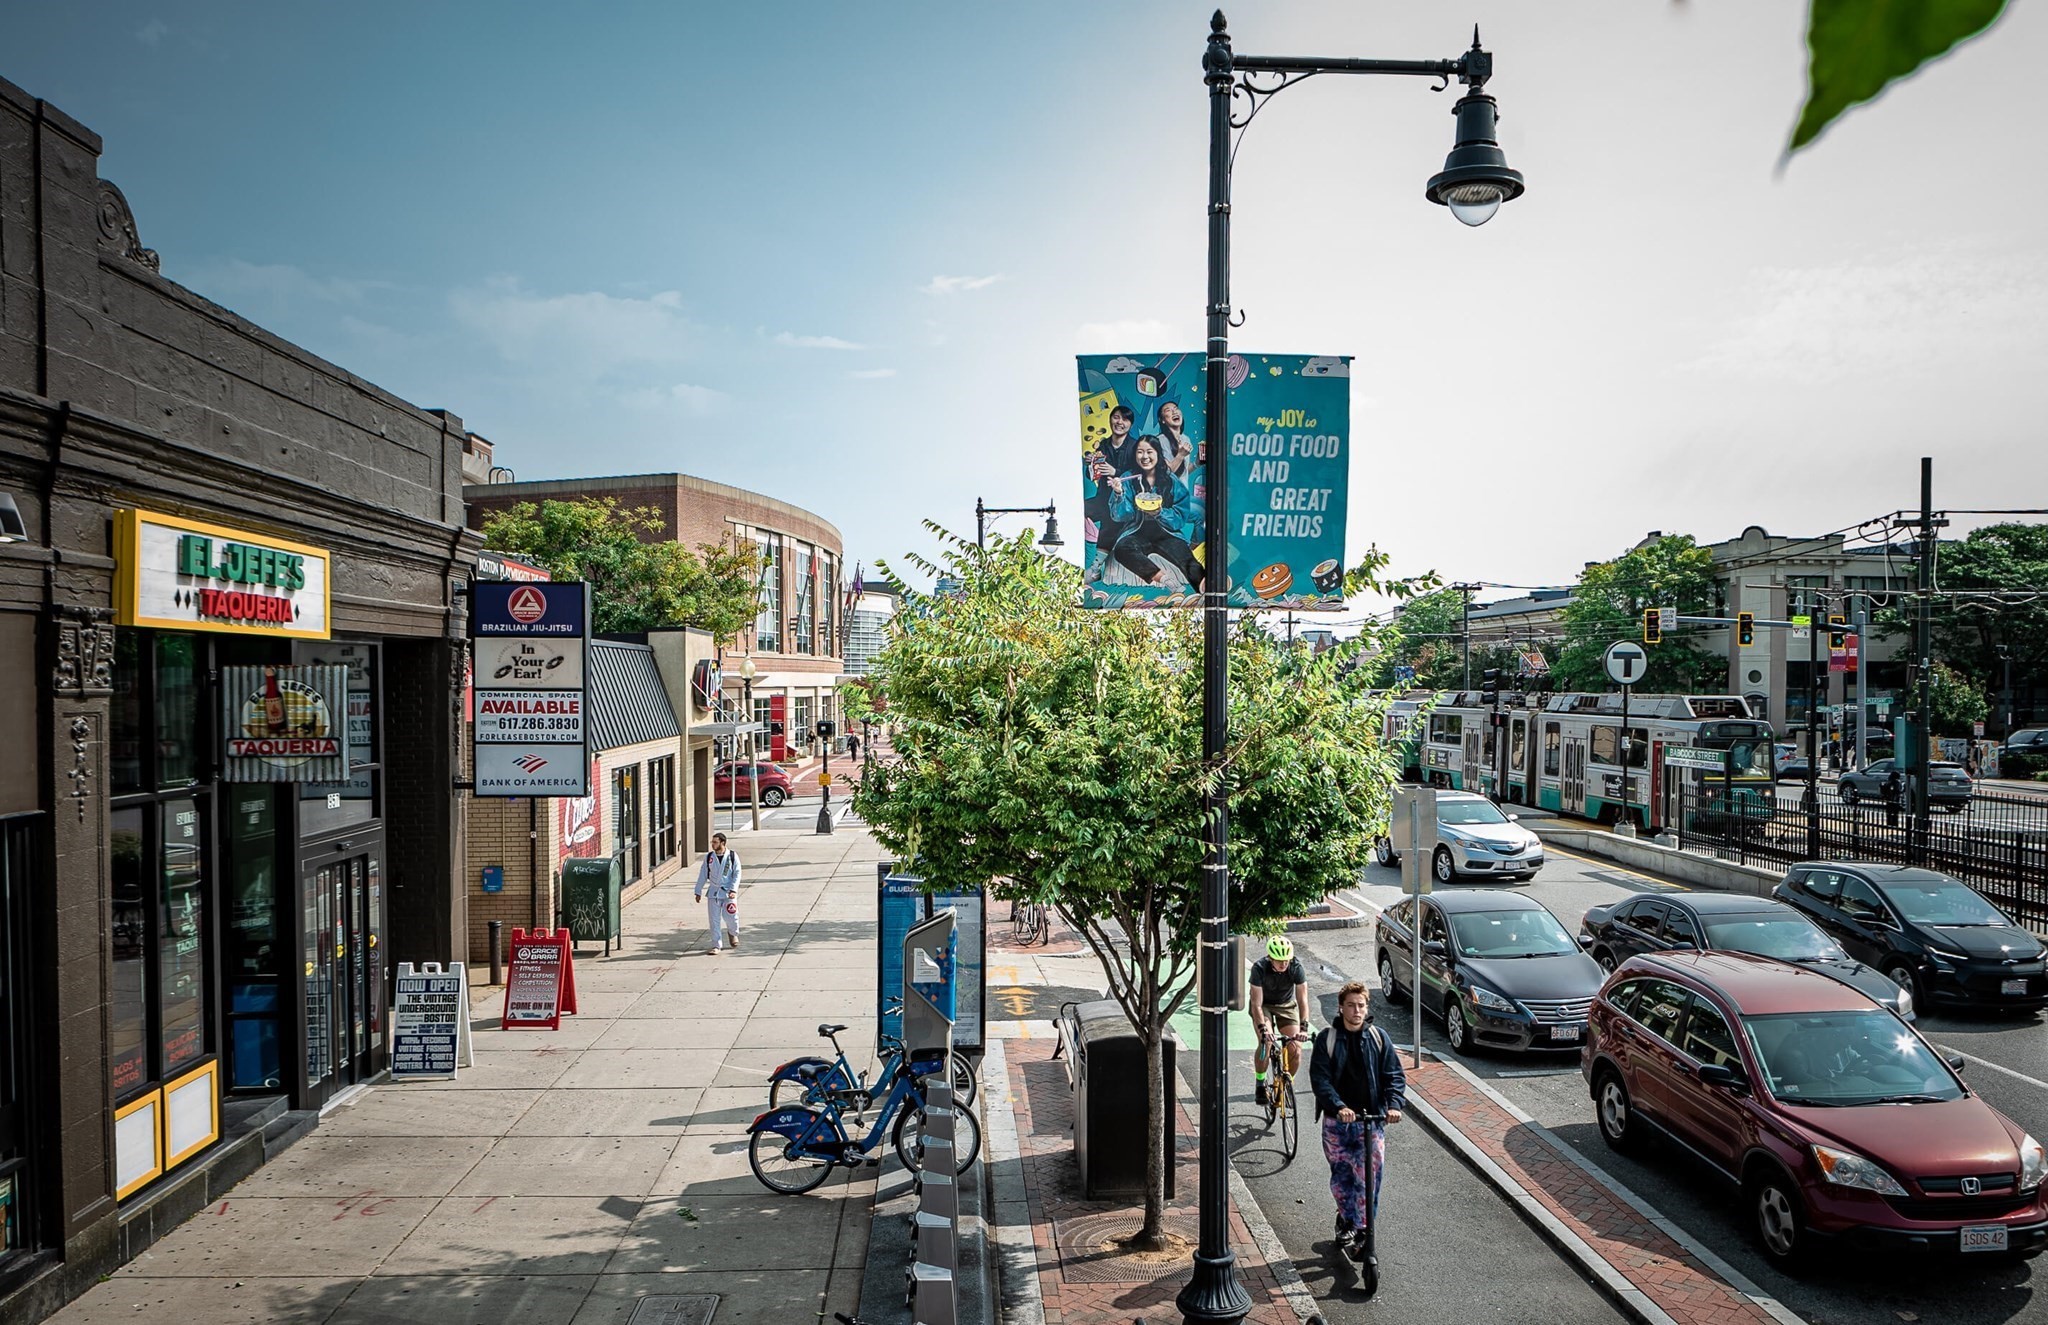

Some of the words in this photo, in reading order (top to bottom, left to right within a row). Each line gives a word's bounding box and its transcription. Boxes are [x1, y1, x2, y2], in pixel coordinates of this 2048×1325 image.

[1257, 417, 1275, 432] my
[1276, 409, 1305, 428] JOY
[1231, 433, 1284, 456] GOOD
[1290, 434, 1340, 458] FOOD
[1248, 460, 1290, 483] AND
[1270, 487, 1332, 512] GREAT
[1241, 513, 1323, 538] FRIENDS
[181, 534, 220, 578] EL
[223, 542, 305, 590] JEFE'S
[478, 558, 498, 576] BOSTON
[199, 588, 293, 622] TAQUERIA
[521, 644, 535, 654] In
[511, 656, 545, 666] Your
[1612, 652, 1642, 678] T
[513, 668, 542, 679] Ear!
[249, 690, 266, 705] EL
[280, 682, 321, 704] JEFE'S
[480, 700, 579, 714] AVAILABLE
[499, 718, 579, 730] 617.286.3830
[232, 740, 337, 755] TAQUERIA
[1670, 748, 1696, 759] BABCOCK
[1697, 751, 1719, 761] STREET
[400, 980, 426, 992] NOW
[430, 980, 458, 992] OPEN
[407, 994, 421, 1003] THE
[424, 994, 457, 1003] VINTAGE
[399, 1004, 456, 1013] UNDERGROUND
[424, 1014, 456, 1022] BOSTON
[1565, 1029, 1577, 1037] 677
[113, 1060, 134, 1075] ACOS
[1963, 1232, 1989, 1245] 1SDS
[1992, 1232, 2004, 1244] 42
